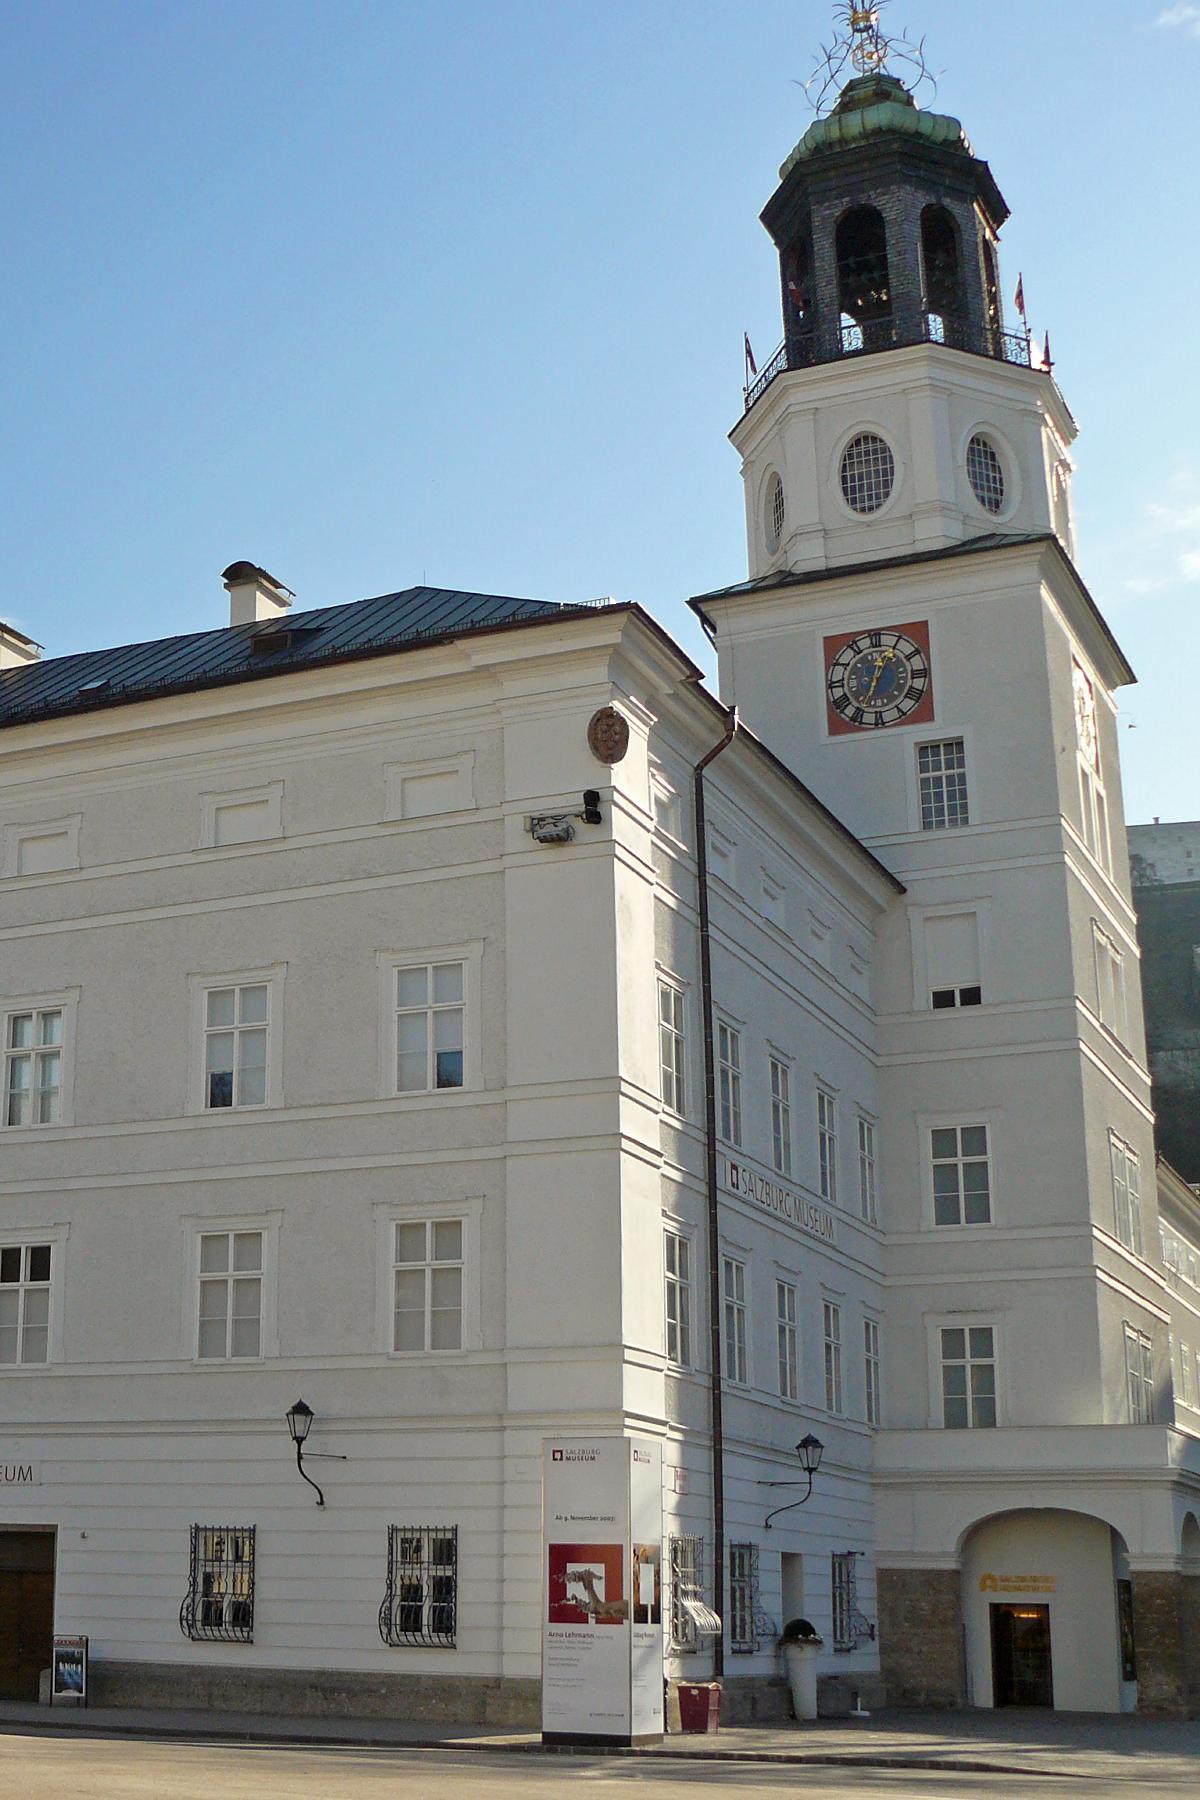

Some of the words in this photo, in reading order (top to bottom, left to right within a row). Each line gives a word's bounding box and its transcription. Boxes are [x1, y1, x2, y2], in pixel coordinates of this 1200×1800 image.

[741, 1168, 792, 1219] SALZBURG
[793, 1195, 834, 1240] MUSEUM
[565, 1631, 595, 1639] Lehmann
